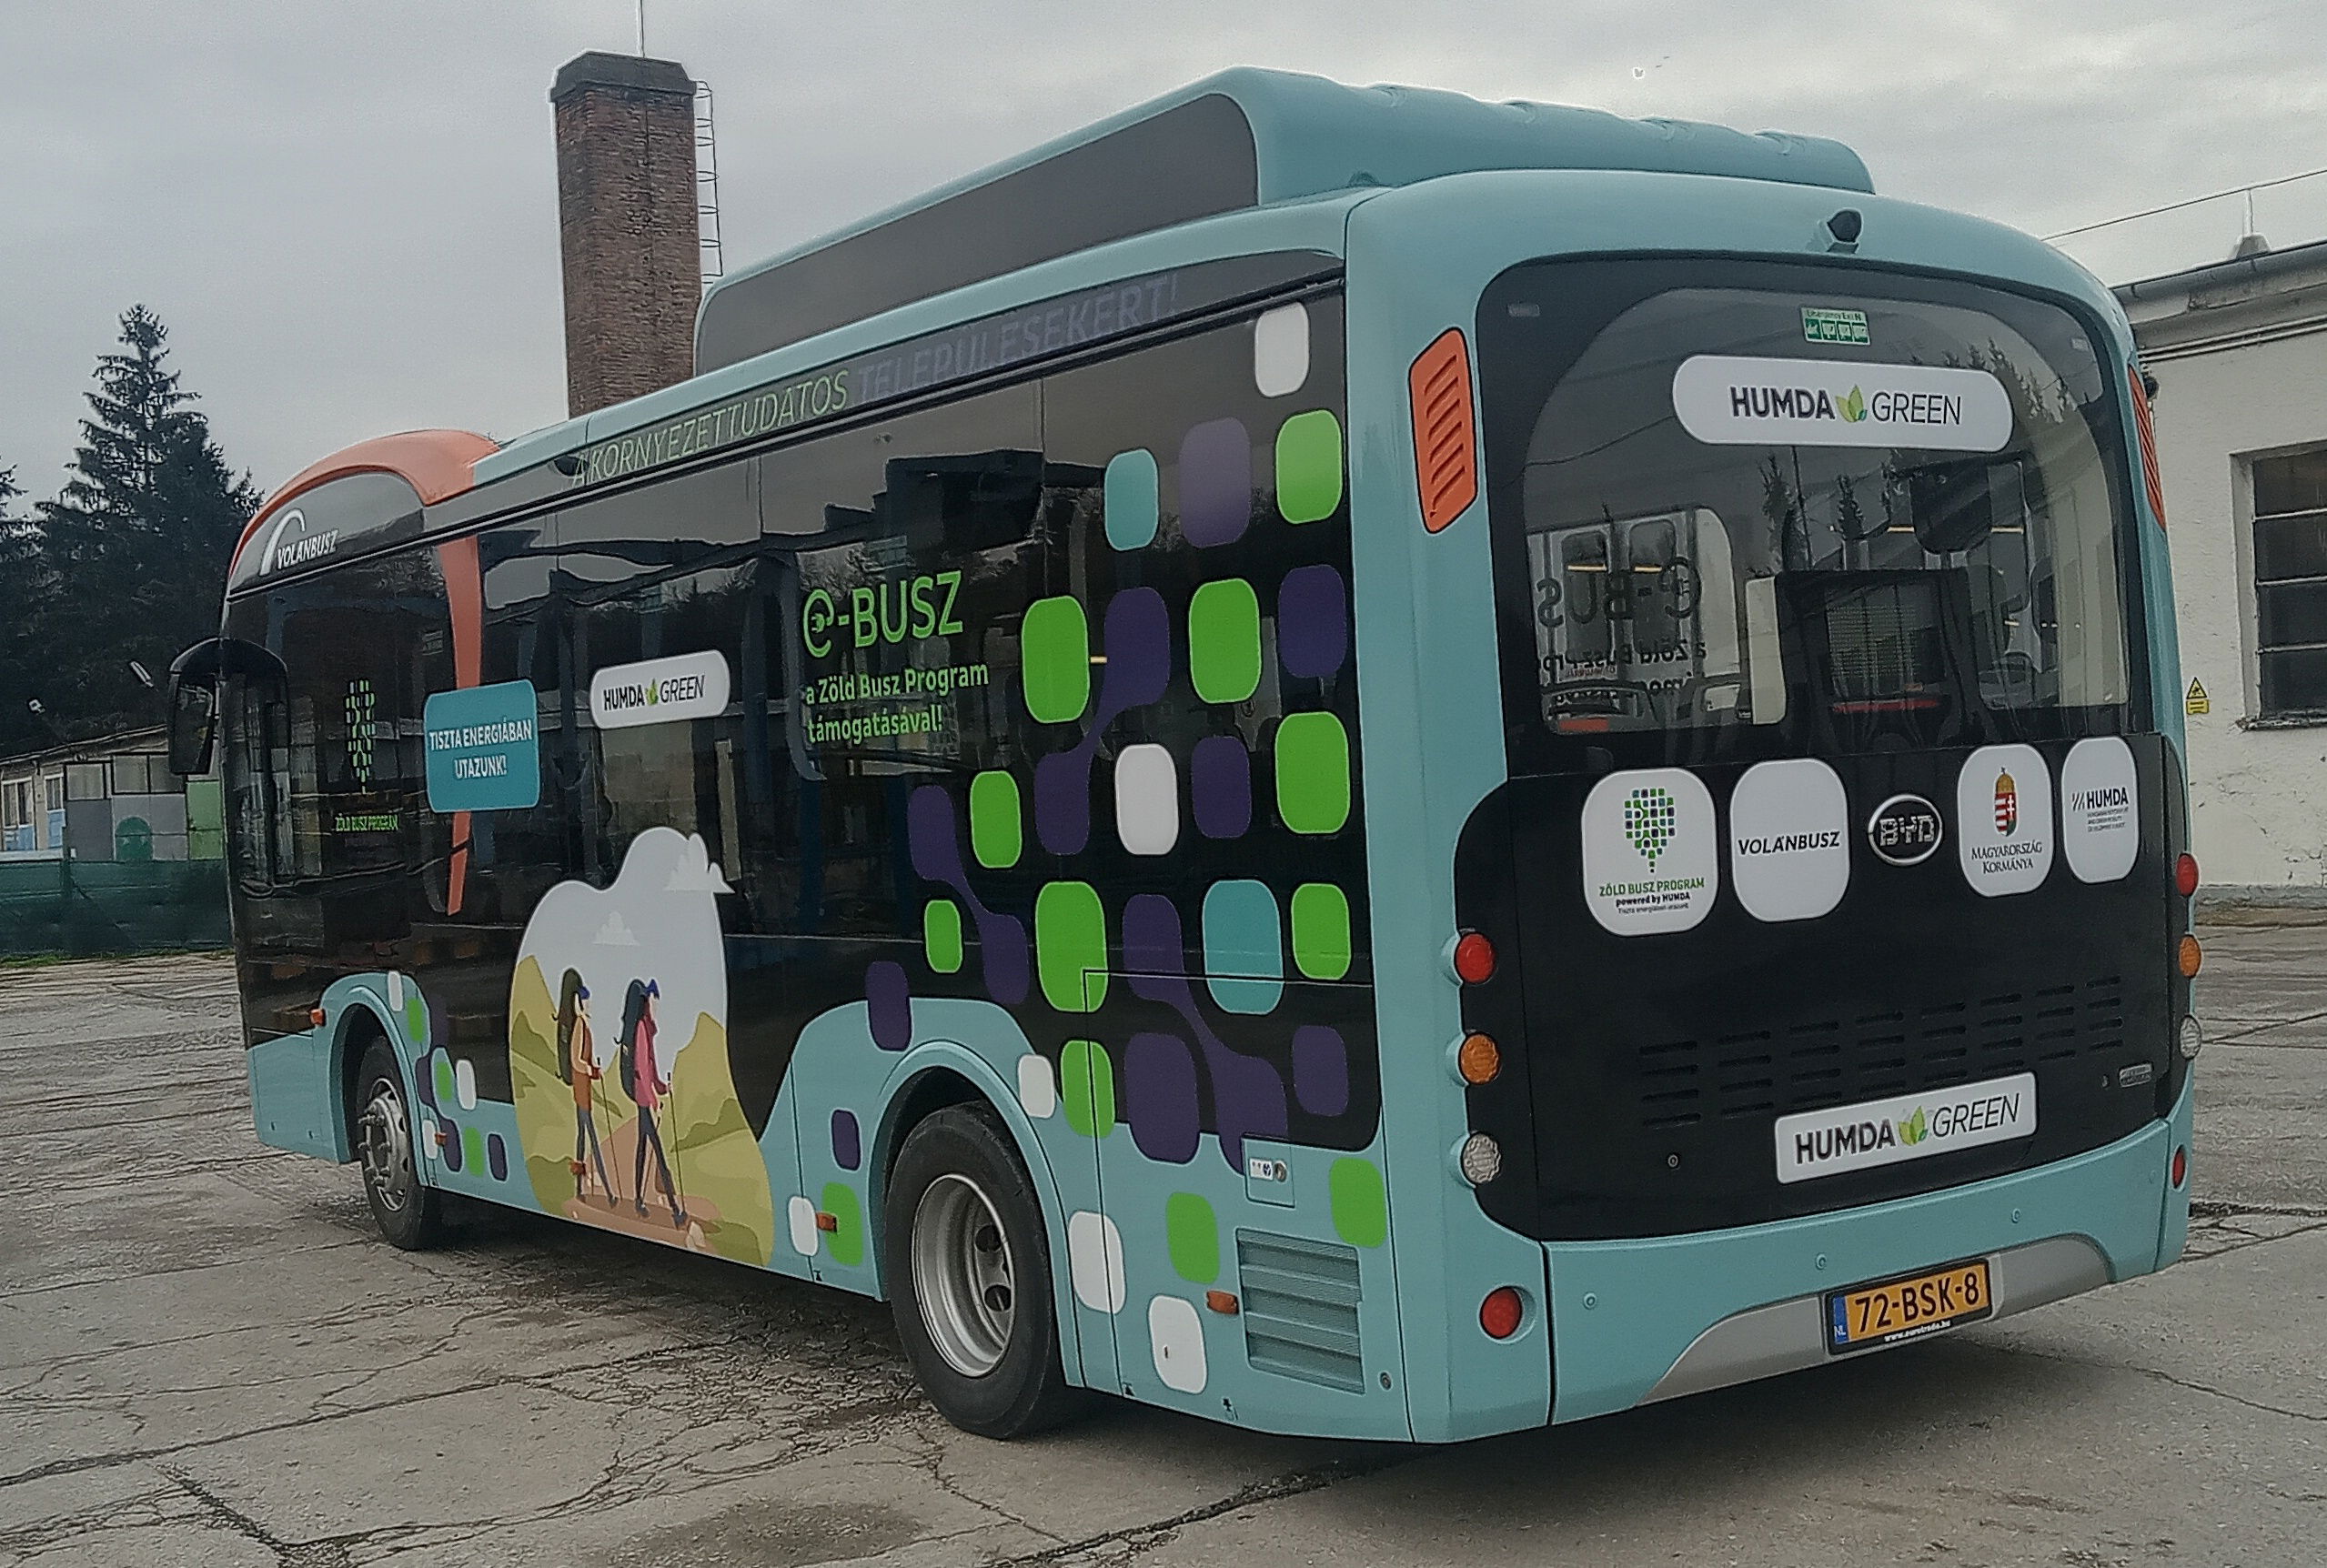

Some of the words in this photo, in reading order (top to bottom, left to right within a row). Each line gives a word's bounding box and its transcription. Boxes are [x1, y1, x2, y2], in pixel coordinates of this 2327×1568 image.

[1730, 387, 1836, 420] HUMDA
[1871, 391, 1961, 425] GREEN
[603, 684, 645, 711] HUMDA
[660, 675, 705, 704] GREEN
[806, 685, 815, 704] a
[819, 676, 855, 704] Zöld
[861, 674, 901, 699] Busz
[906, 663, 989, 697] Program
[428, 729, 462, 751] TISZTA
[463, 717, 533, 747] ENERGIÁBAN
[808, 704, 942, 745] támogatásával!
[454, 754, 507, 779] UTAZUNK!
[2086, 787, 2129, 809] HUMDA
[1738, 829, 1841, 856] VOLÁNBUSZ
[1879, 814, 1935, 847] BYD
[1616, 895, 1650, 908] powered
[1651, 894, 1661, 905] by
[1662, 891, 1691, 902] HUMDA
[1627, 881, 1656, 894] BUSZ
[1657, 877, 1705, 892] PROGRAM
[1795, 1118, 1896, 1164] HUMDA
[1932, 1092, 2020, 1137] GREEN
[1855, 1271, 1979, 1333] 72-BSK-8
[1833, 1325, 1847, 1338] NL
